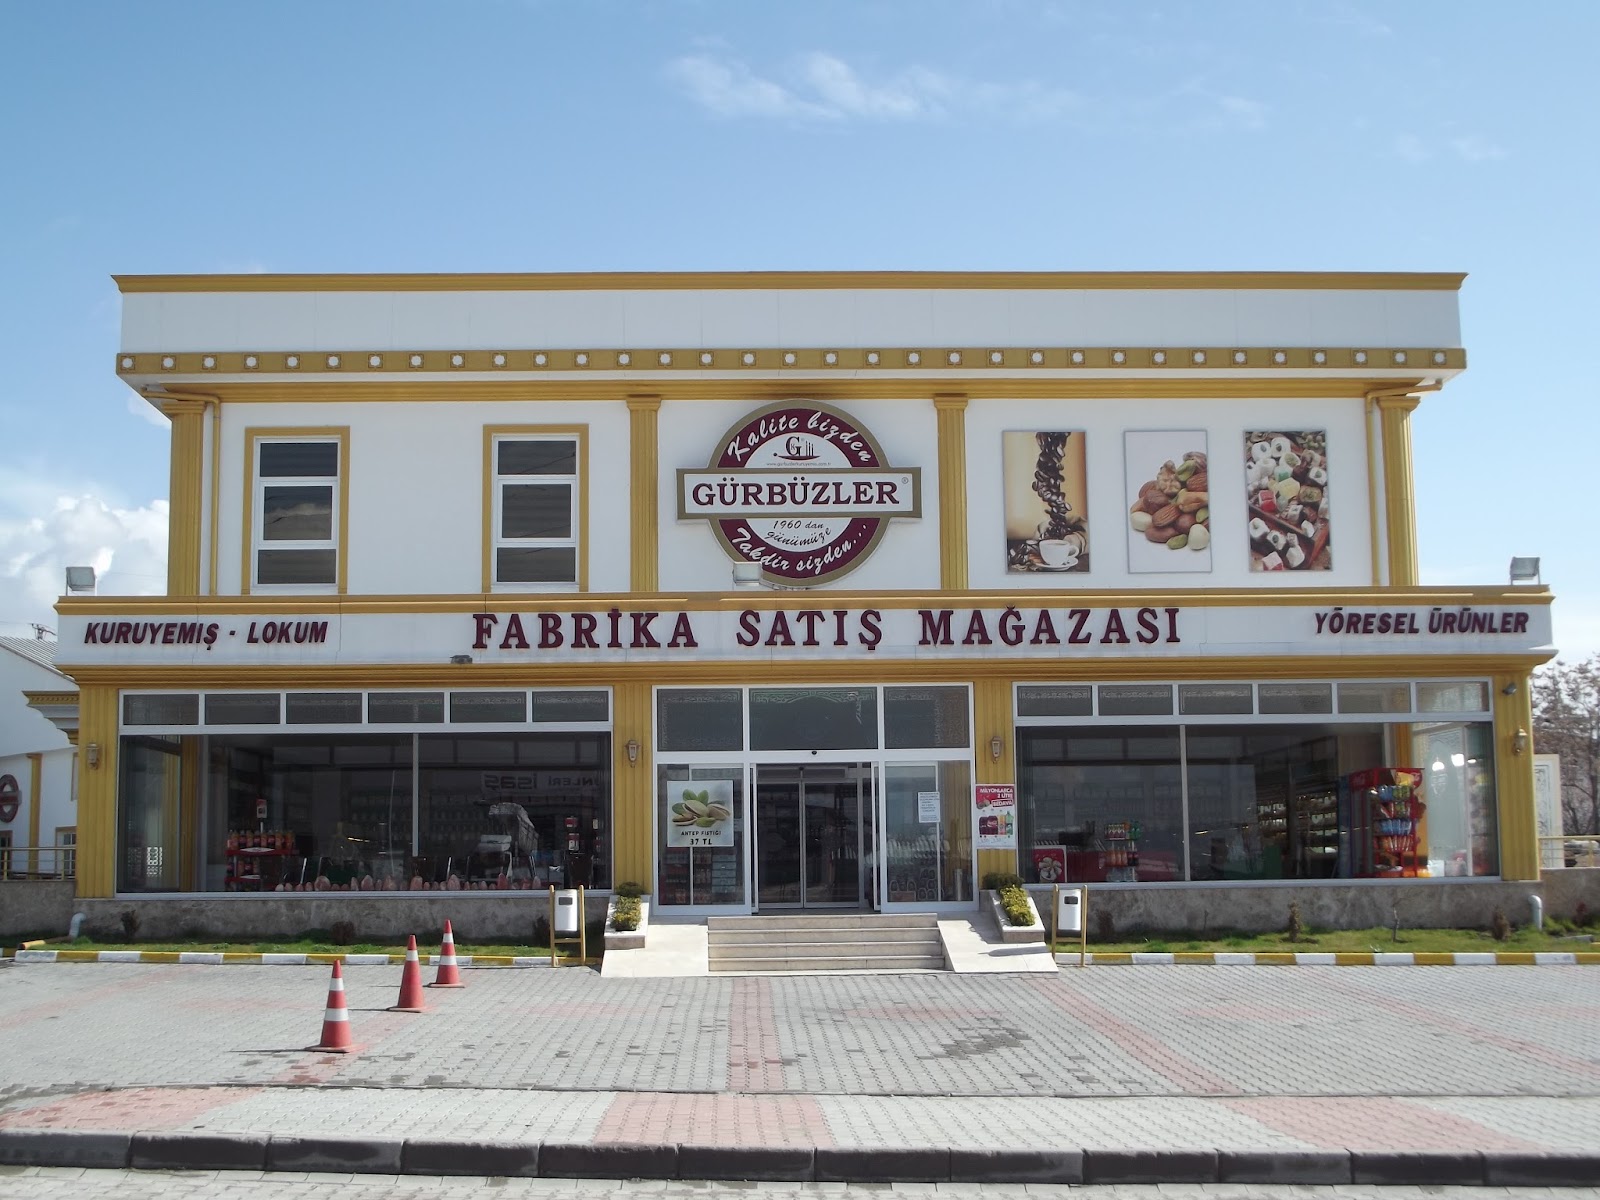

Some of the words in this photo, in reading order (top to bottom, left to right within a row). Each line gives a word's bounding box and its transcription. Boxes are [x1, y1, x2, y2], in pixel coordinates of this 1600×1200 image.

[727, 416, 799, 462] Kalite
[807, 411, 872, 462] bizden
[692, 476, 900, 506] GÜRBÜZLER
[764, 527, 832, 546] günümüze
[772, 520, 802, 529] 1960
[804, 520, 824, 529] dan
[731, 527, 790, 571] Takdir
[246, 621, 328, 644] LOKUM
[472, 608, 699, 649] FABRİKA
[736, 609, 883, 651] SATIŞ
[918, 605, 1181, 646] MAĞAZASI
